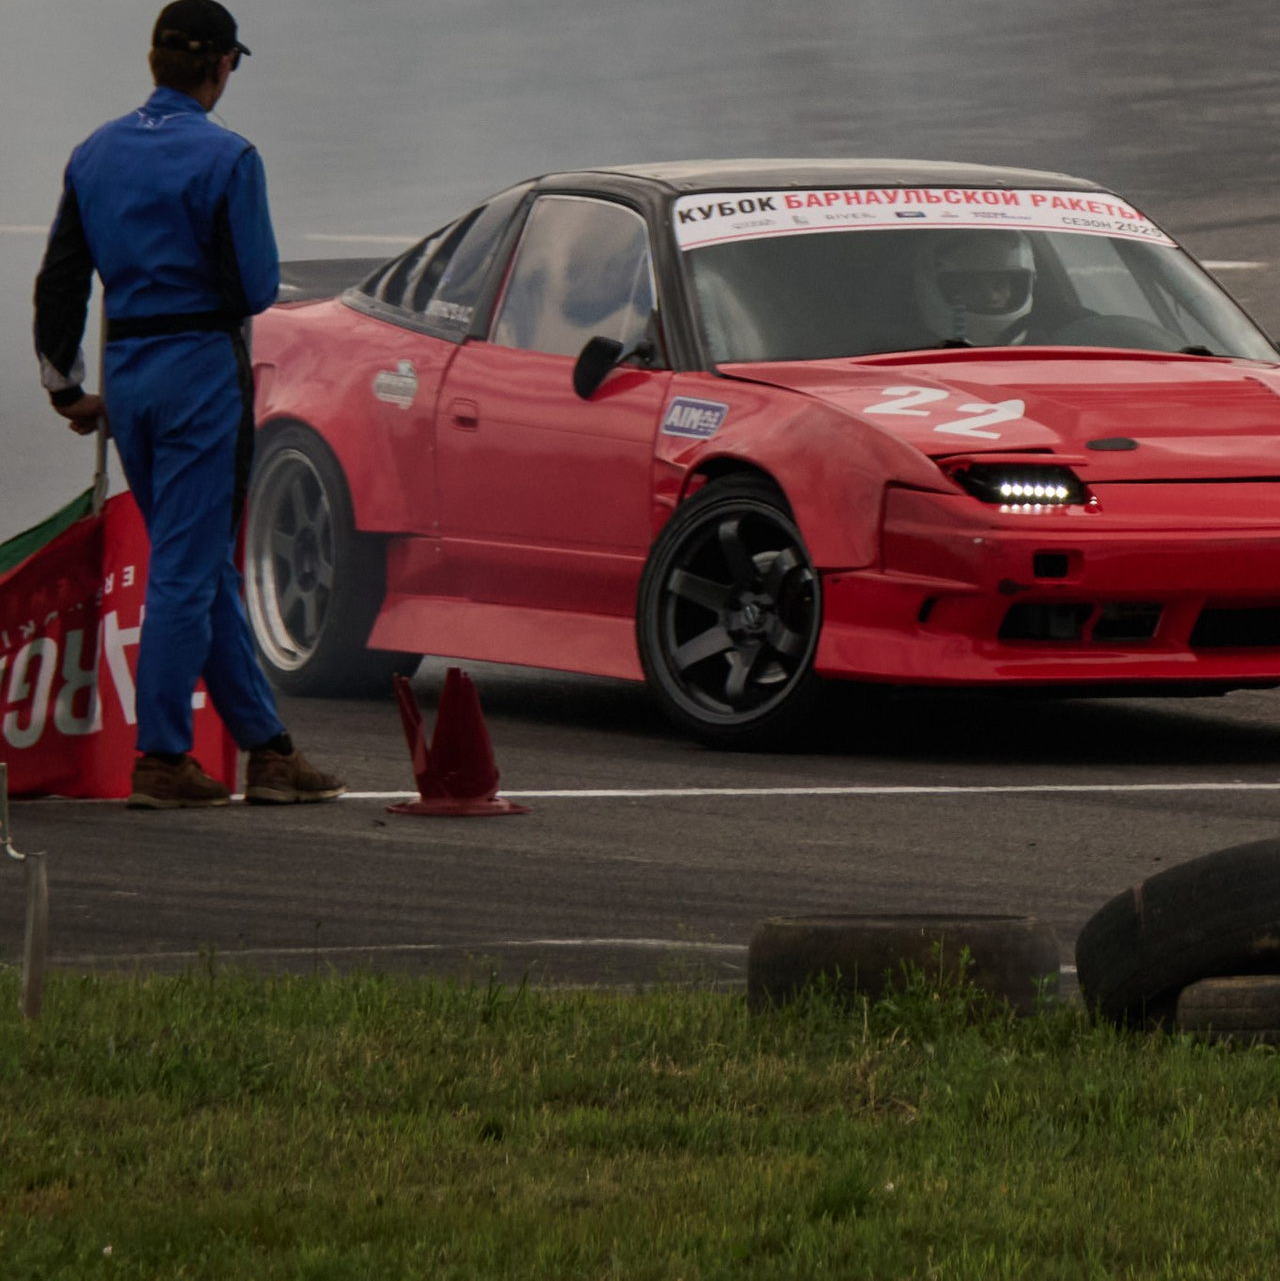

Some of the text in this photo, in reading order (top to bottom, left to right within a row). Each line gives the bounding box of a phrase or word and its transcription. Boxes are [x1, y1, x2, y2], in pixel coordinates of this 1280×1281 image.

[678, 196, 776, 224] КУБОК
[785, 188, 1020, 210] БАРНАУЛЬСКОЙ
[1061, 216, 1112, 229] СЕЗОН
[667, 405, 703, 430] AIM
[864, 385, 1026, 440] 22
